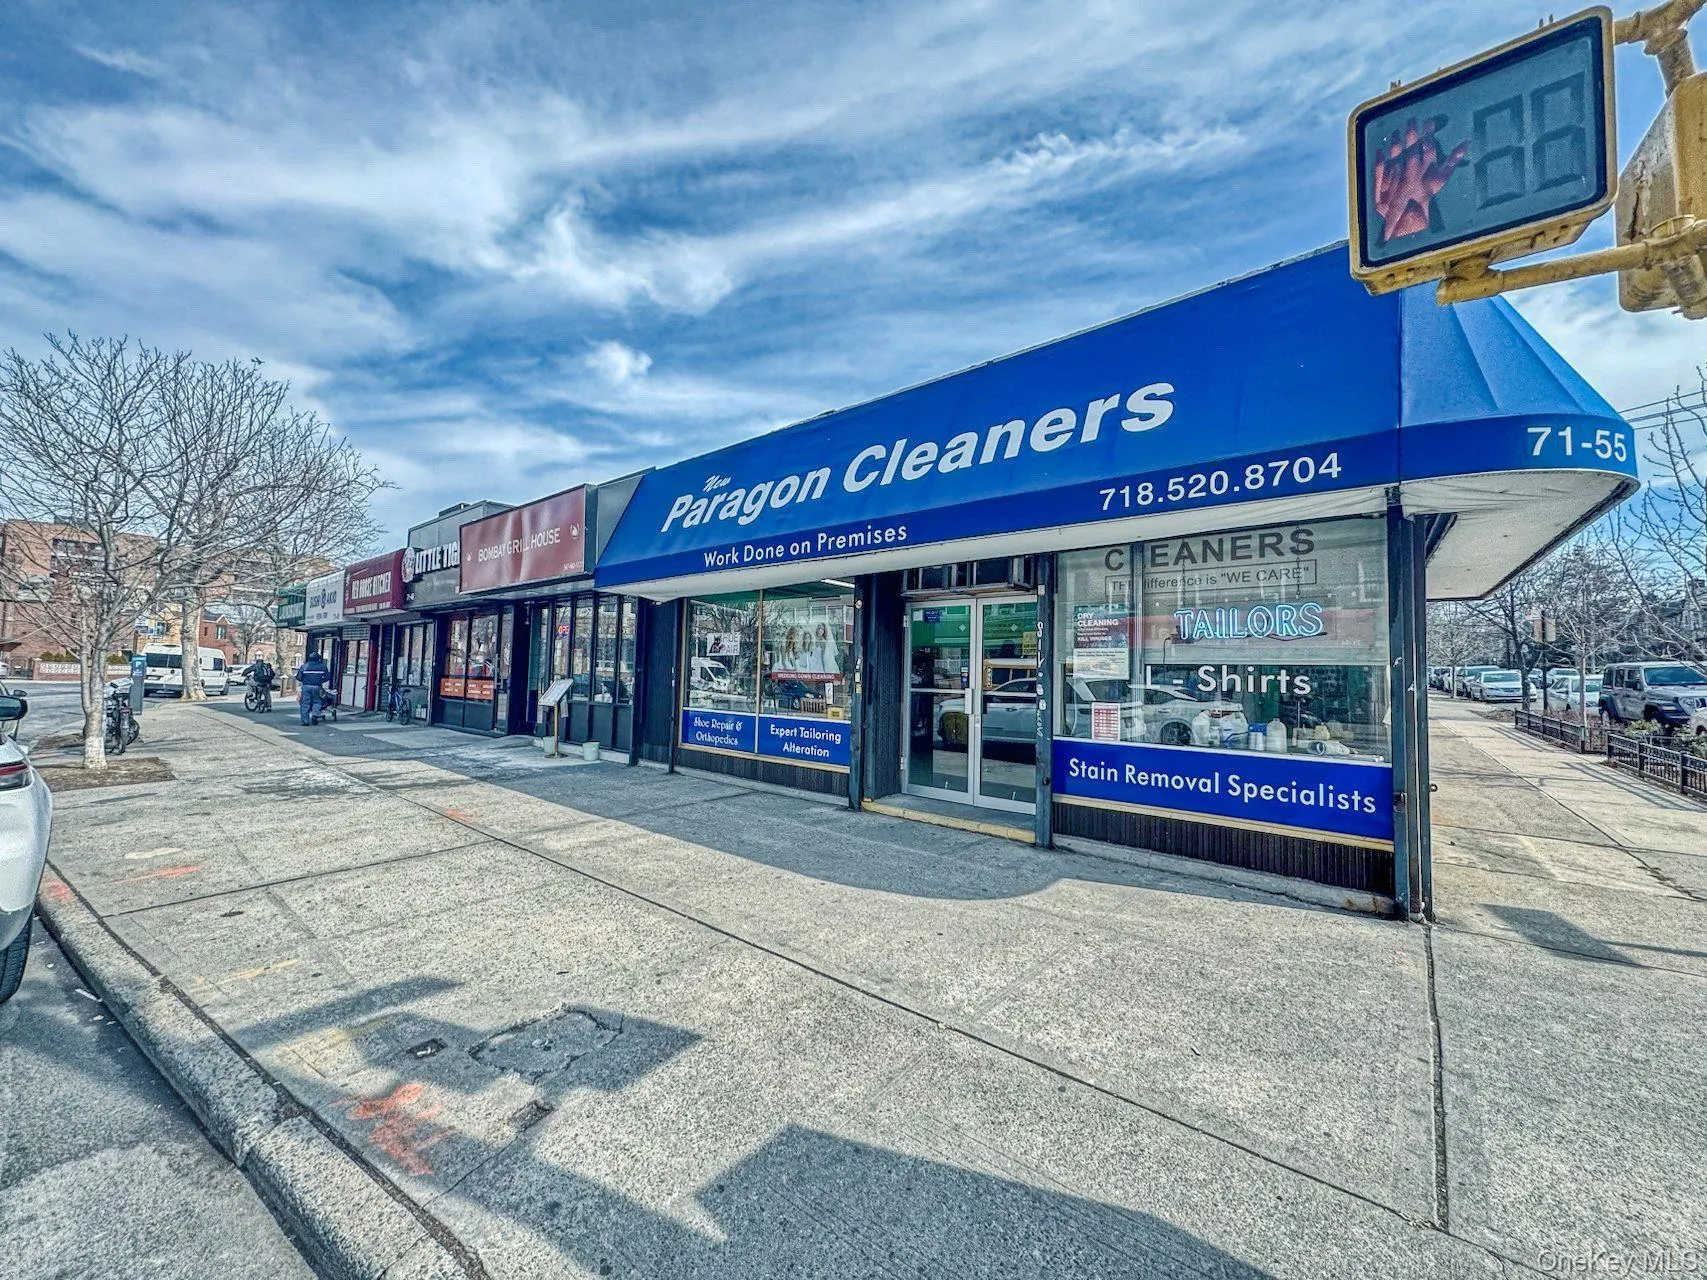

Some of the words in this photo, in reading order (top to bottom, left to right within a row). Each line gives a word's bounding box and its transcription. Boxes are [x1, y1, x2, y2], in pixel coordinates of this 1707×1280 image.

[661, 467, 831, 532] Paragon
[843, 382, 1175, 494] Cleaners
[1526, 426, 1628, 462] 71-55
[702, 475, 732, 493] New
[1099, 452, 1342, 512] 718.520.8704
[478, 542, 508, 562] BOMBAY
[507, 537, 531, 554] GRILL
[531, 527, 561, 548] HOUSE
[704, 550, 739, 567] Work
[744, 543, 784, 562] Done
[790, 540, 812, 556] on
[818, 525, 908, 551] Premises
[1104, 528, 1315, 571] CEANERS
[415, 545, 441, 575] LITTLE
[1206, 574, 1217, 585] is
[1077, 619, 1119, 627] CLEANING
[1173, 602, 1324, 640] TAILORS
[1197, 665, 1311, 695] Shirts
[693, 717, 709, 728] Shoe
[711, 718, 734, 732] Repair
[695, 731, 739, 746] Orthopedics
[770, 724, 797, 737] Expert
[799, 727, 841, 744] Tailoring
[783, 742, 829, 757] Alteration
[1069, 757, 1118, 782] Stain
[1125, 764, 1220, 794] Removal
[1228, 774, 1376, 813] Specialists
